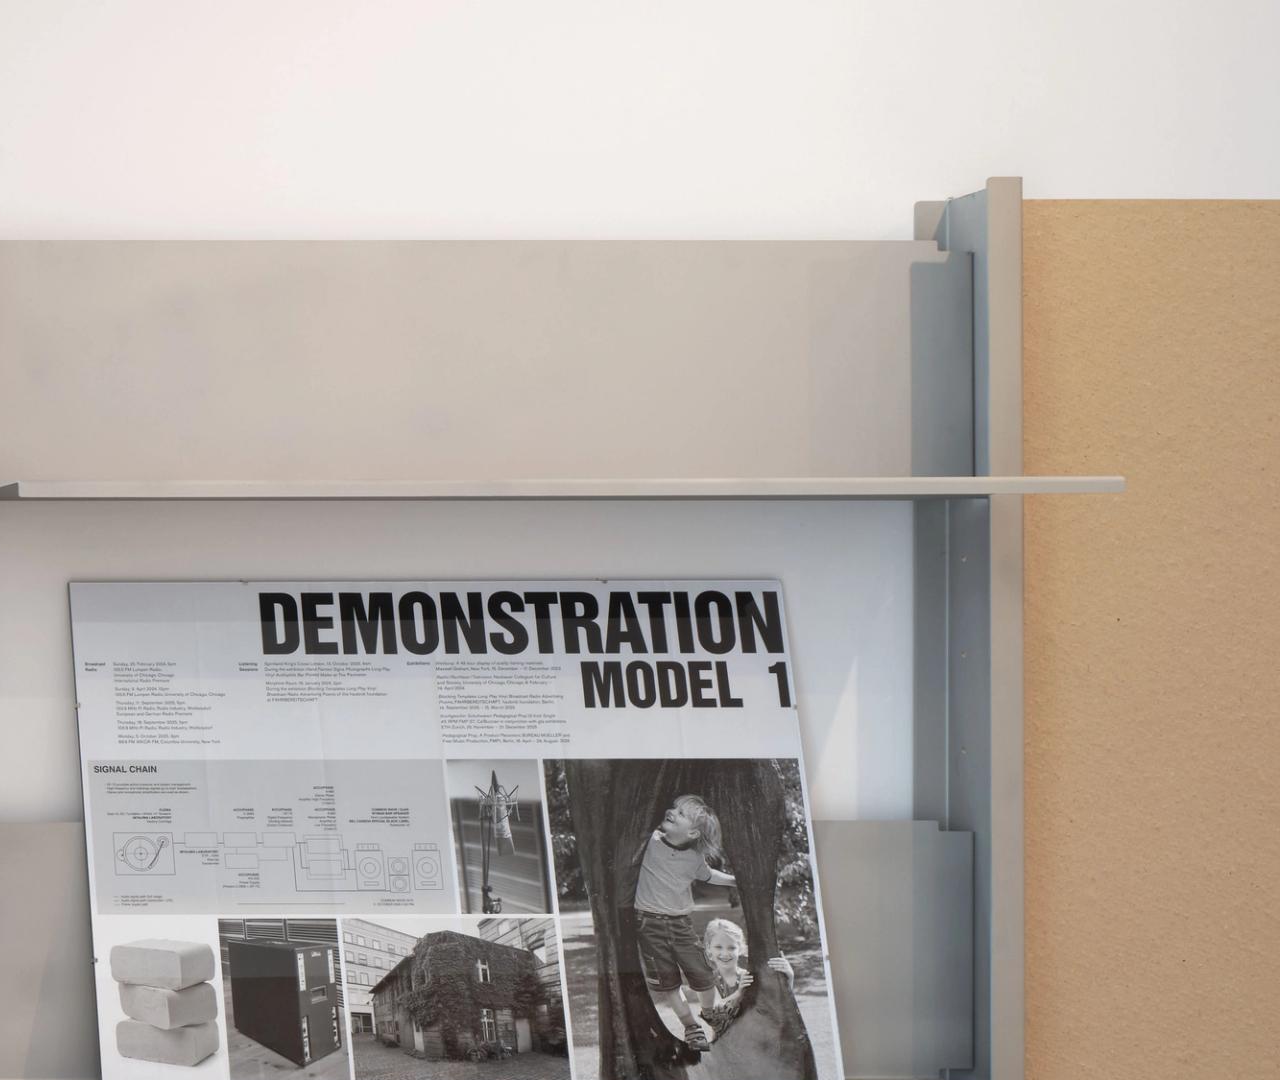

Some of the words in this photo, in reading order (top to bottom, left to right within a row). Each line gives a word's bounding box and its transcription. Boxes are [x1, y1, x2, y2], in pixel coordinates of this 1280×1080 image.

[259, 591, 784, 655] DEMONSTRATION
[581, 661, 743, 708] MODEL
[771, 662, 791, 707] 1
